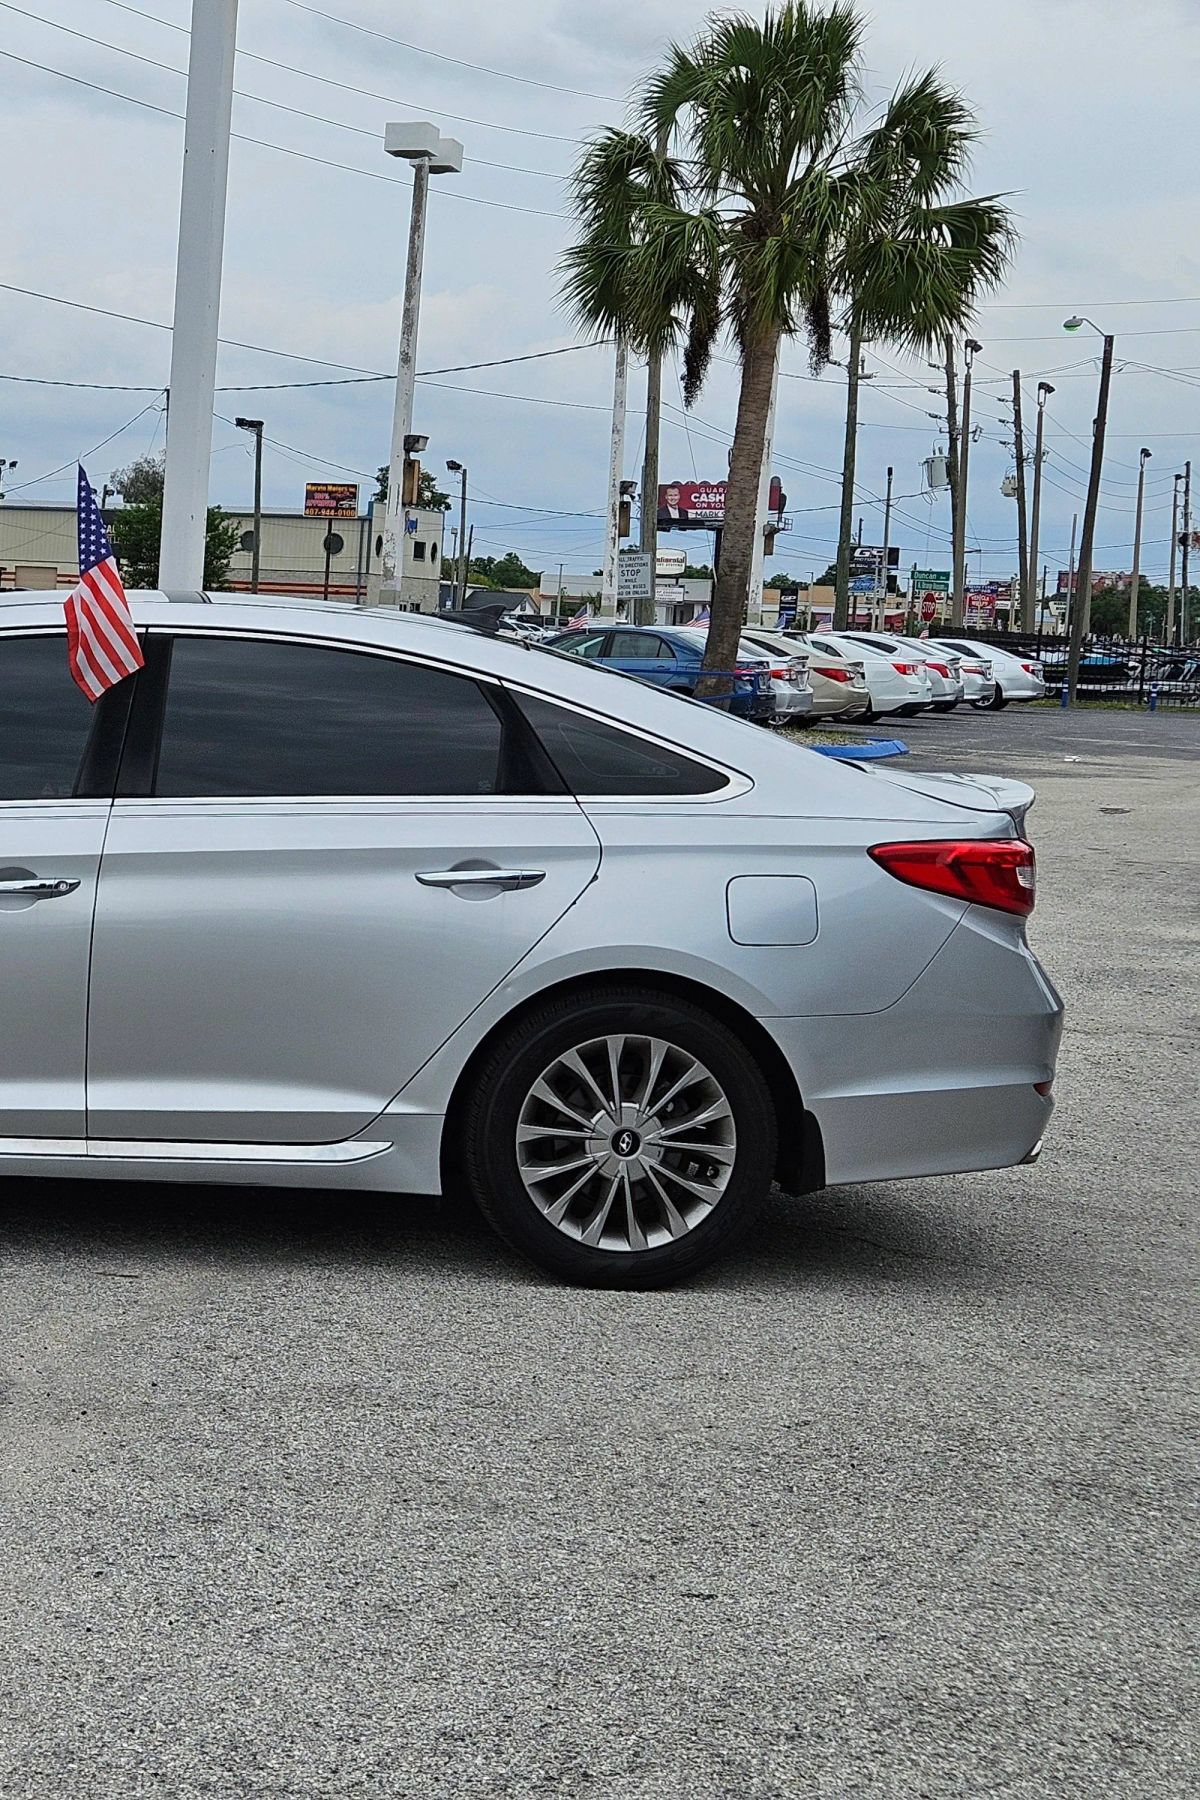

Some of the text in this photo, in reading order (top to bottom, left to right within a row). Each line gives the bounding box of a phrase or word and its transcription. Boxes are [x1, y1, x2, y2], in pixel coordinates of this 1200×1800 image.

[690, 493, 725, 503] CASH
[913, 571, 937, 580] Duncan
[922, 601, 936, 613] STOP
